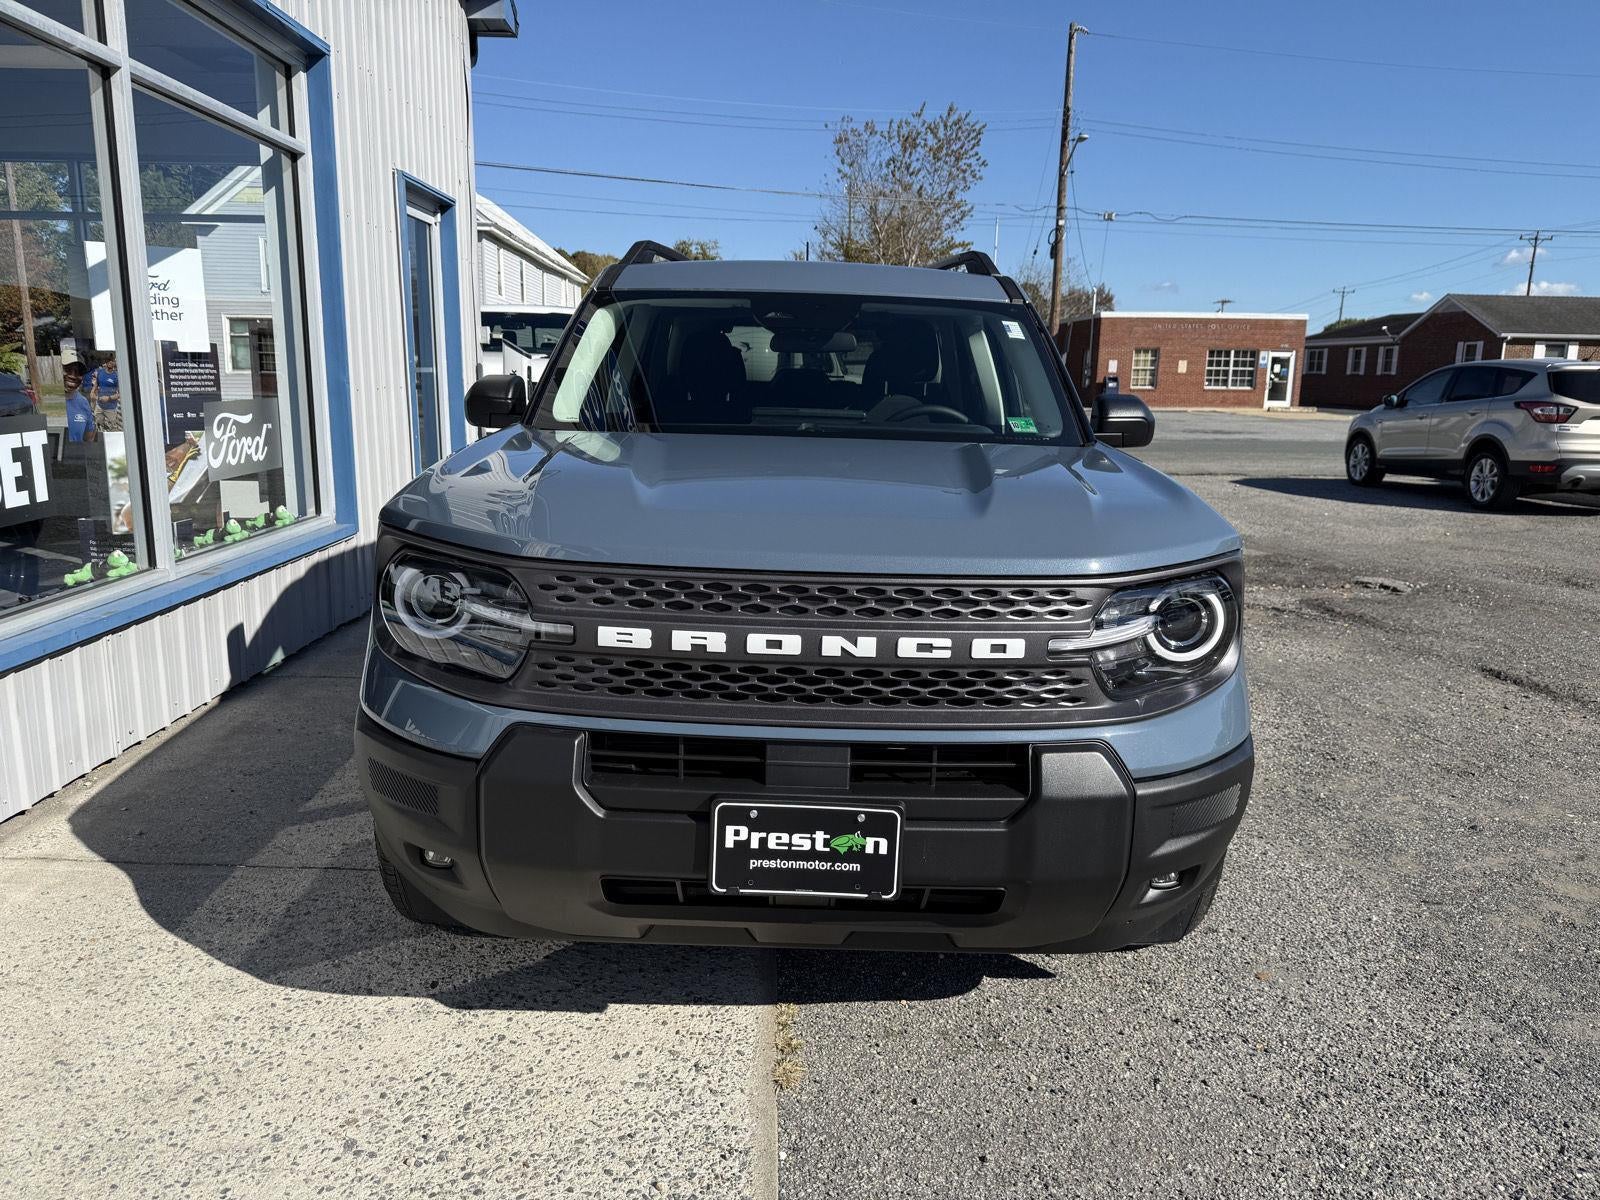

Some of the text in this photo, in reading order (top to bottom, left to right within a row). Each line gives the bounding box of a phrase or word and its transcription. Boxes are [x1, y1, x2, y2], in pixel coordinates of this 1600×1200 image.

[150, 293, 180, 308] ding
[208, 412, 268, 469] Ford
[0, 429, 49, 509] ET
[597, 625, 1026, 659] BRONCO
[724, 825, 888, 855] Prestn
[749, 858, 861, 872] prestonmotor.com
